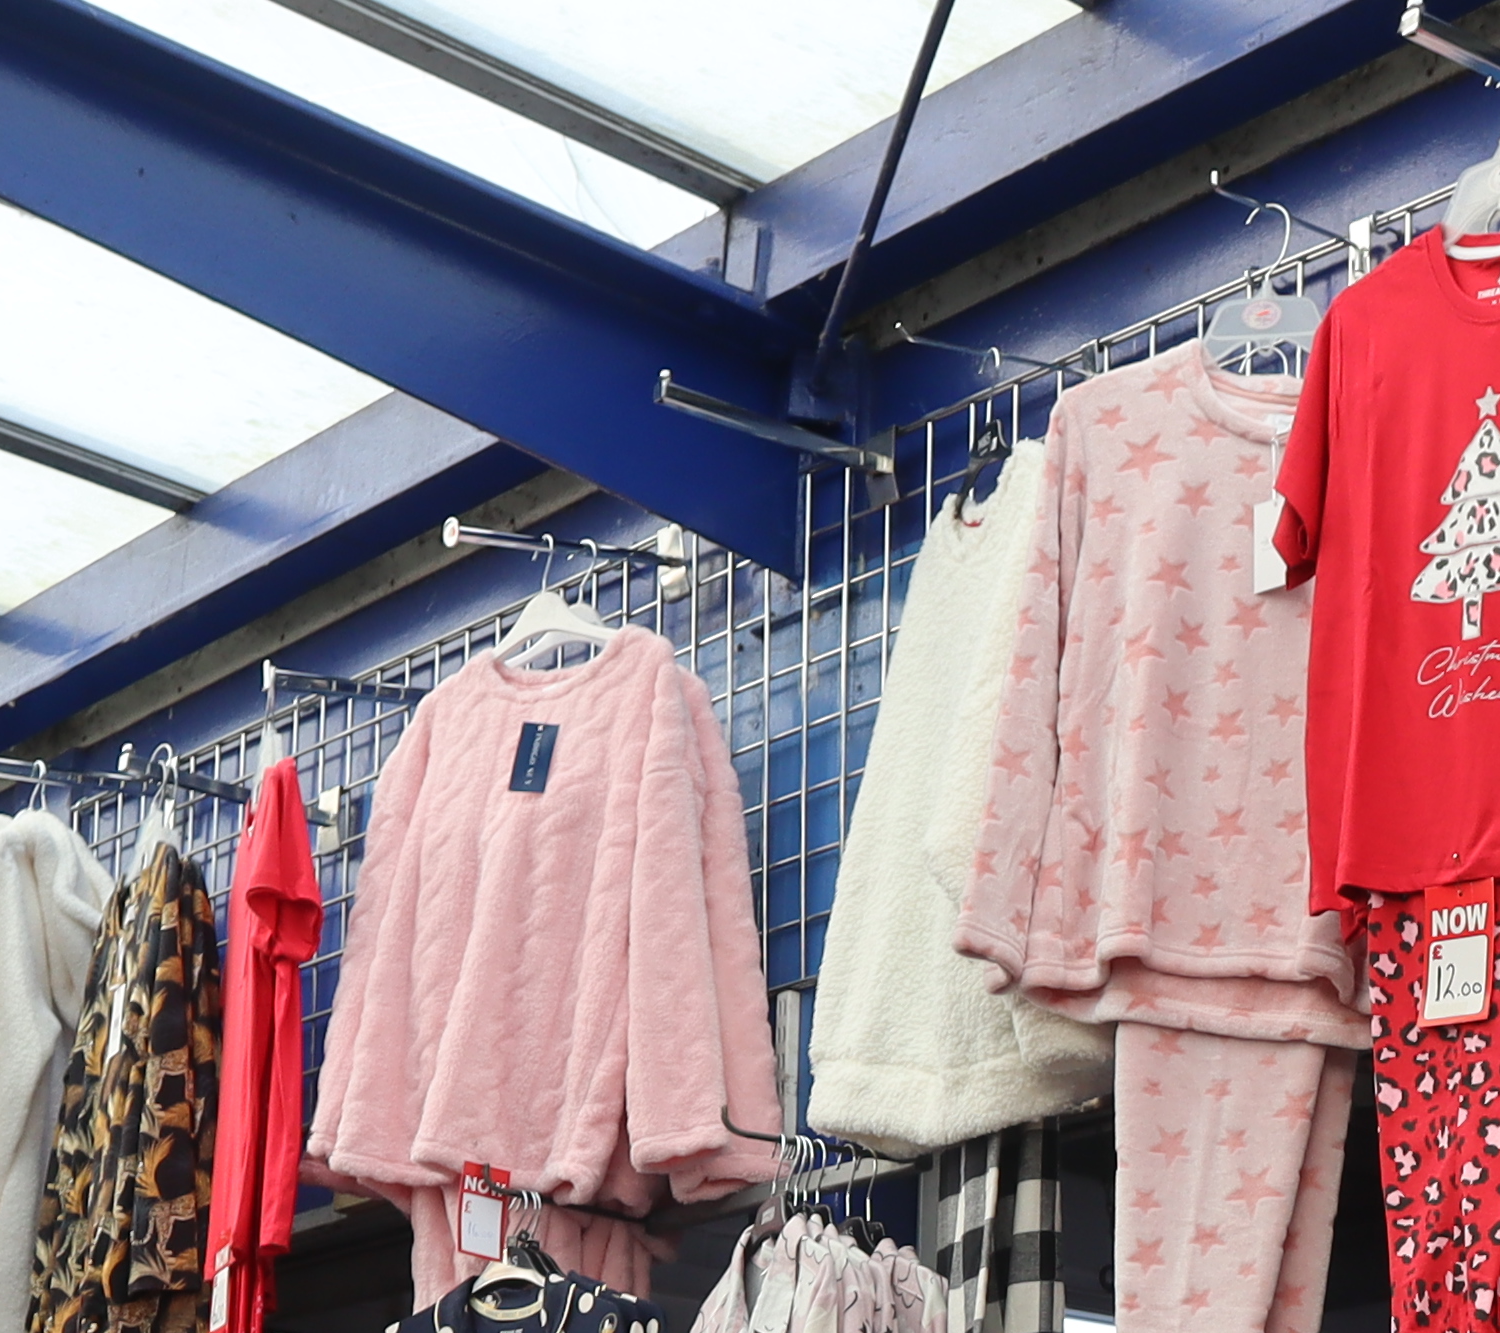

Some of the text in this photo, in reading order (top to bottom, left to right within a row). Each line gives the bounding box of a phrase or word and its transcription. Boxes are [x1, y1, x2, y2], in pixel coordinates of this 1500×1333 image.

[1431, 902, 1488, 937] NOW
[1432, 945, 1443, 960] £
[1435, 964, 1482, 1001] 12.00
